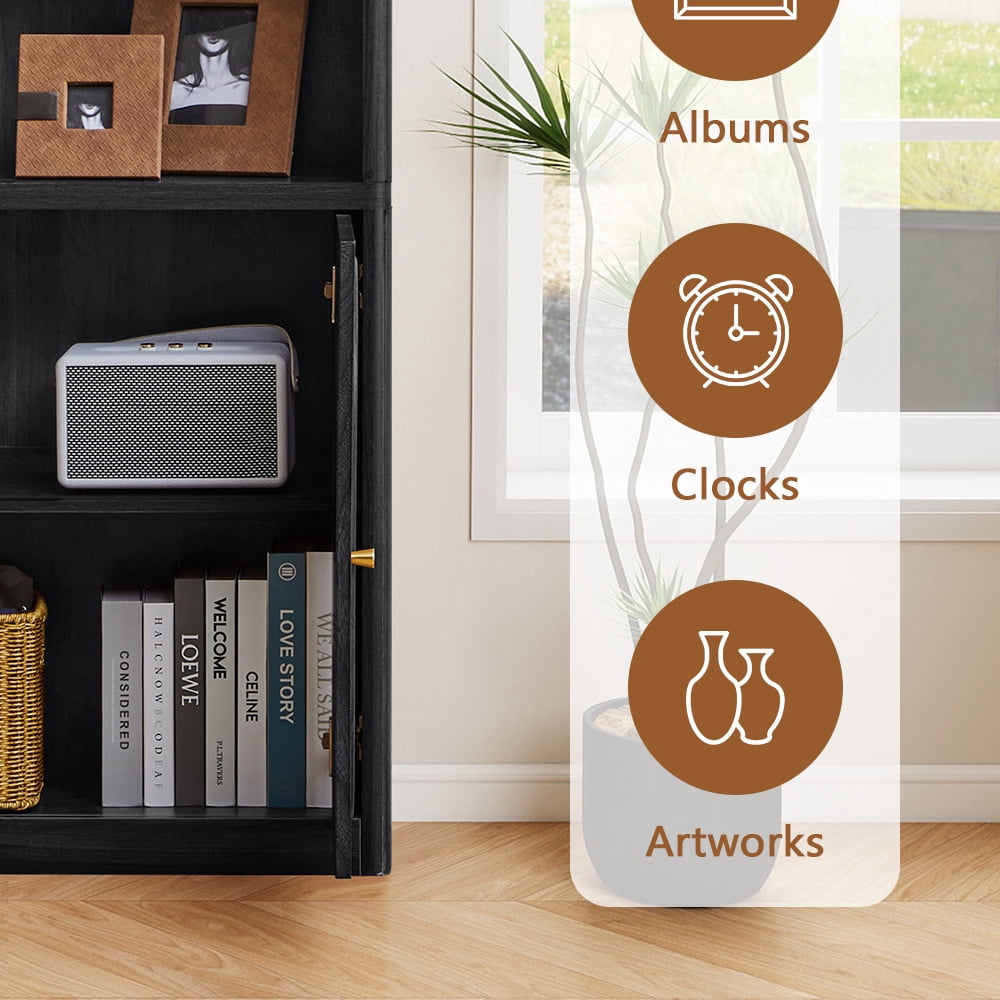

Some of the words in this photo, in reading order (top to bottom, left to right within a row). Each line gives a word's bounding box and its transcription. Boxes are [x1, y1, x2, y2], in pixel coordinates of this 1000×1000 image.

[213, 597, 227, 680] WELCOME
[279, 609, 294, 658] LOVE
[317, 612, 332, 645] WE
[181, 633, 199, 706] LOEWE
[245, 671, 258, 723] CELINE
[279, 663, 294, 725] STORY
[317, 649, 332, 689] ALL
[119, 650, 130, 750] CONSIDERED
